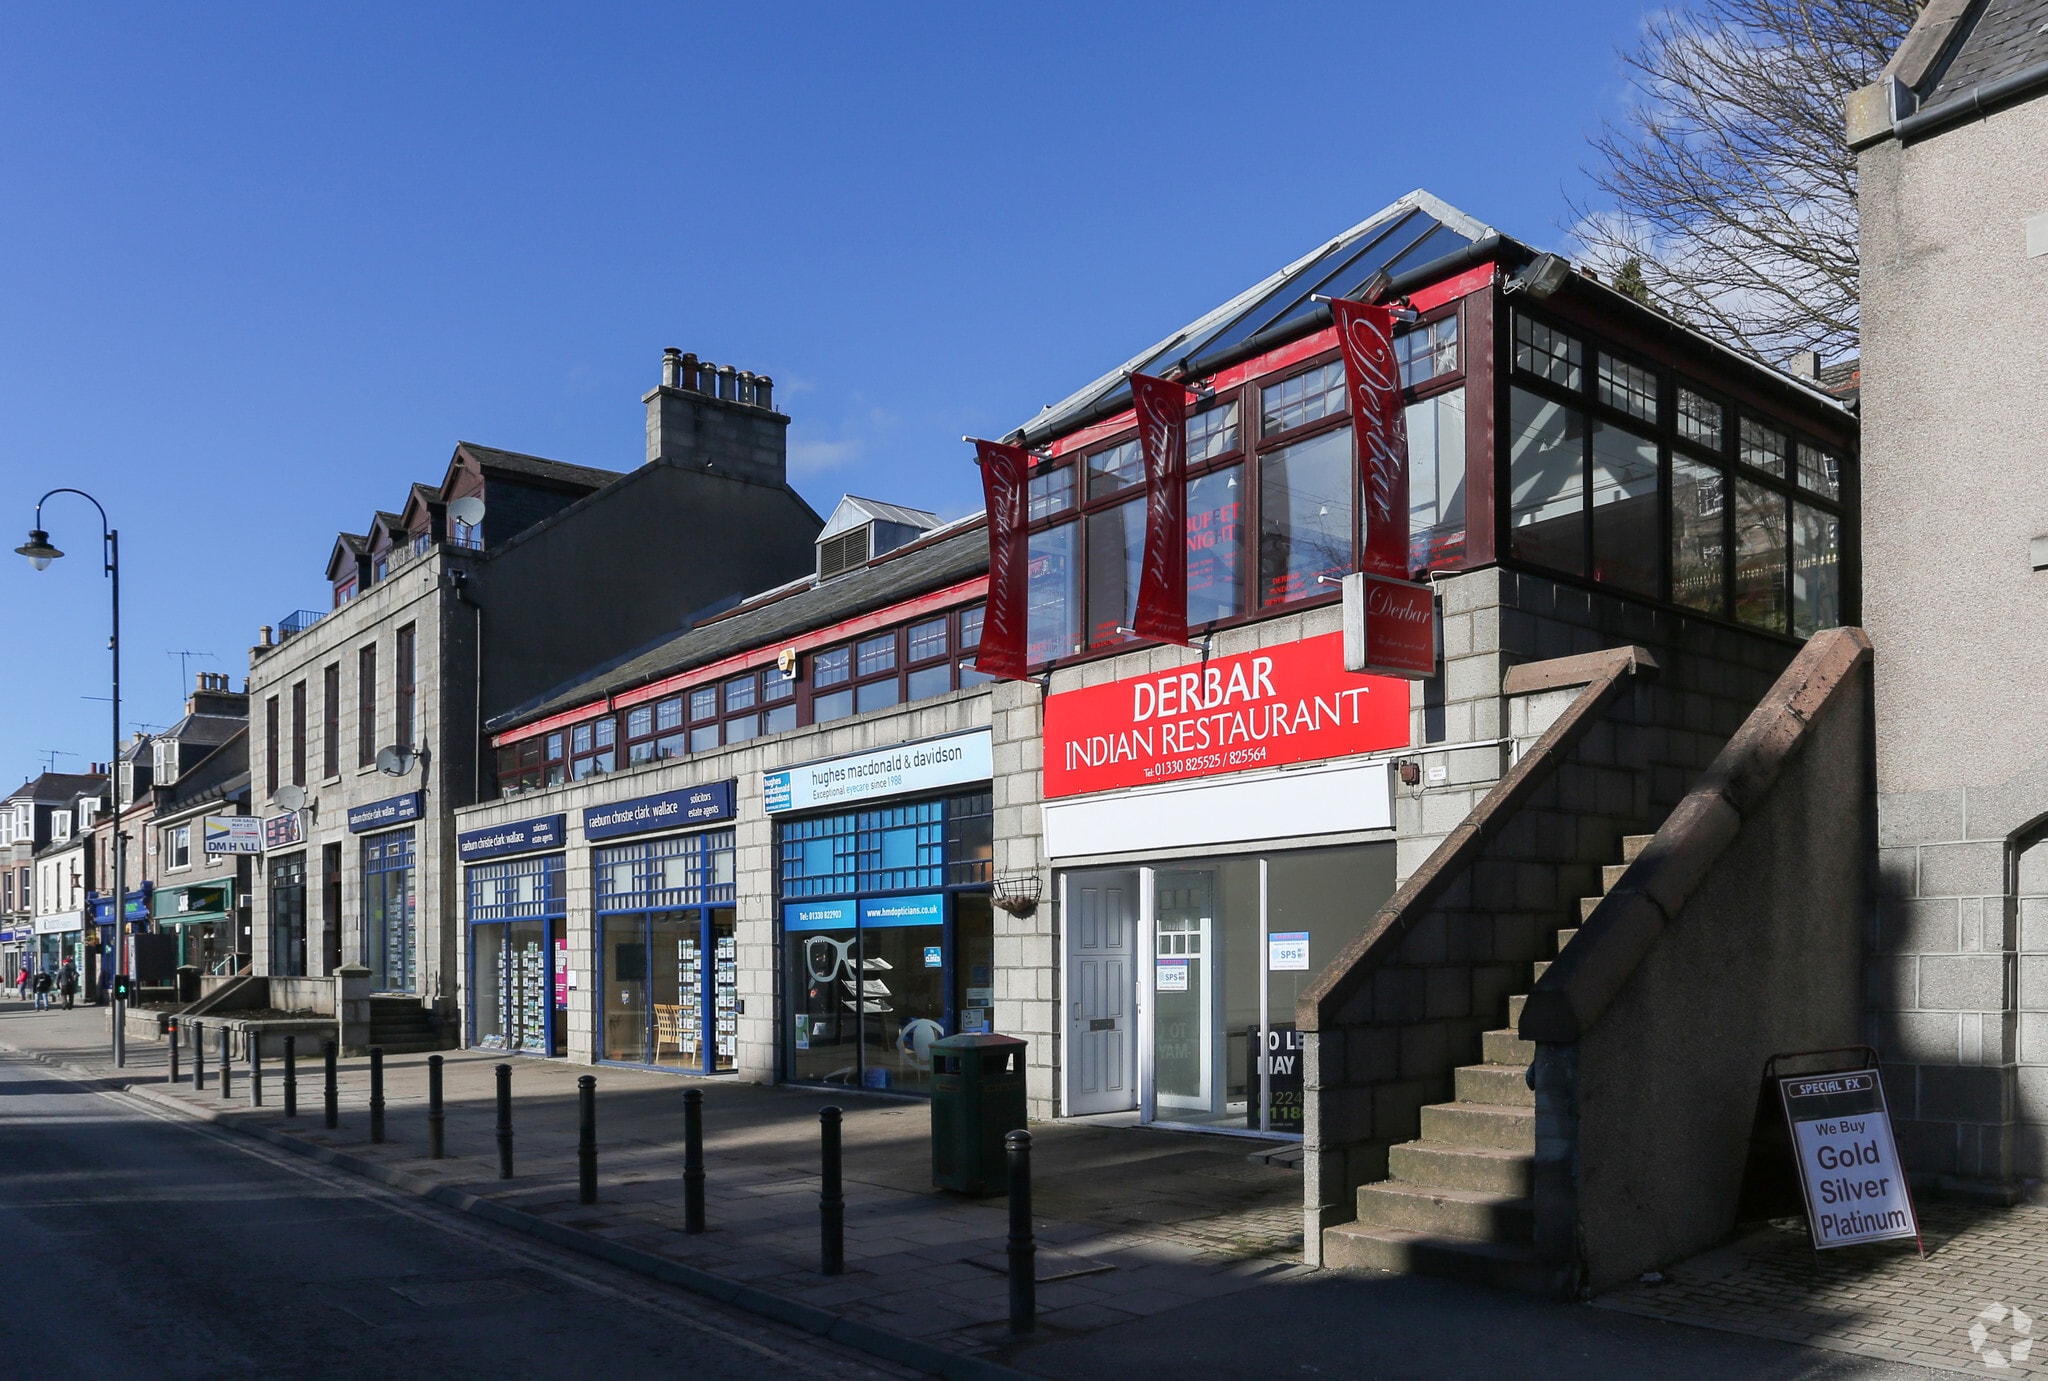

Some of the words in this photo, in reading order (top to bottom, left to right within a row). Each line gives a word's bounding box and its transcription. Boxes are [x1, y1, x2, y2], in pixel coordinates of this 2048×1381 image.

[1341, 308, 1401, 523] Derbar
[987, 450, 1020, 635] Restaurant
[1368, 585, 1430, 624] Derbar
[1133, 656, 1277, 723] DERBAR
[1065, 726, 1160, 771] INDIAN
[1161, 686, 1369, 755] RESTAURANT
[812, 768, 846, 789] hughes
[848, 753, 902, 779] macdonald
[904, 755, 912, 769] &
[913, 745, 962, 767] davidson
[1155, 760, 1183, 777] 01330
[1185, 754, 1221, 772] 825525
[1229, 746, 1267, 765] 825564
[764, 777, 781, 787] hughes
[812, 784, 846, 801] Exceptional
[846, 782, 870, 795] eyecare
[870, 779, 888, 790] since
[888, 776, 902, 787] 1988
[690, 792, 711, 804] solicitors
[589, 813, 611, 828] raeburn
[612, 810, 634, 824] christie
[634, 804, 651, 820] clark
[652, 801, 678, 817] wallace
[688, 807, 702, 818] estate
[703, 804, 719, 817] agents
[208, 842, 226, 851] DM
[229, 842, 257, 851] HALL
[461, 840, 477, 852] raeburn
[478, 835, 493, 849] christie
[493, 834, 506, 847] clark
[506, 831, 525, 843] wallace
[800, 912, 808, 921] Tel:
[809, 911, 823, 920] 01330
[824, 910, 842, 920] 822903
[866, 904, 938, 918] www.hmdopticians.co.uk
[1281, 950, 1296, 959] SPS
[1165, 973, 1178, 981] SPS
[1286, 1031, 1305, 1050] LE
[1800, 1080, 1842, 1095] SPECIAL
[1846, 1078, 1860, 1090] FX
[1815, 1122, 1837, 1137] We
[1840, 1120, 1866, 1135] Buy
[1817, 1139, 1880, 1171] Gold
[1820, 1177, 1890, 1204] Silver
[1820, 1209, 1907, 1238] Platinum
